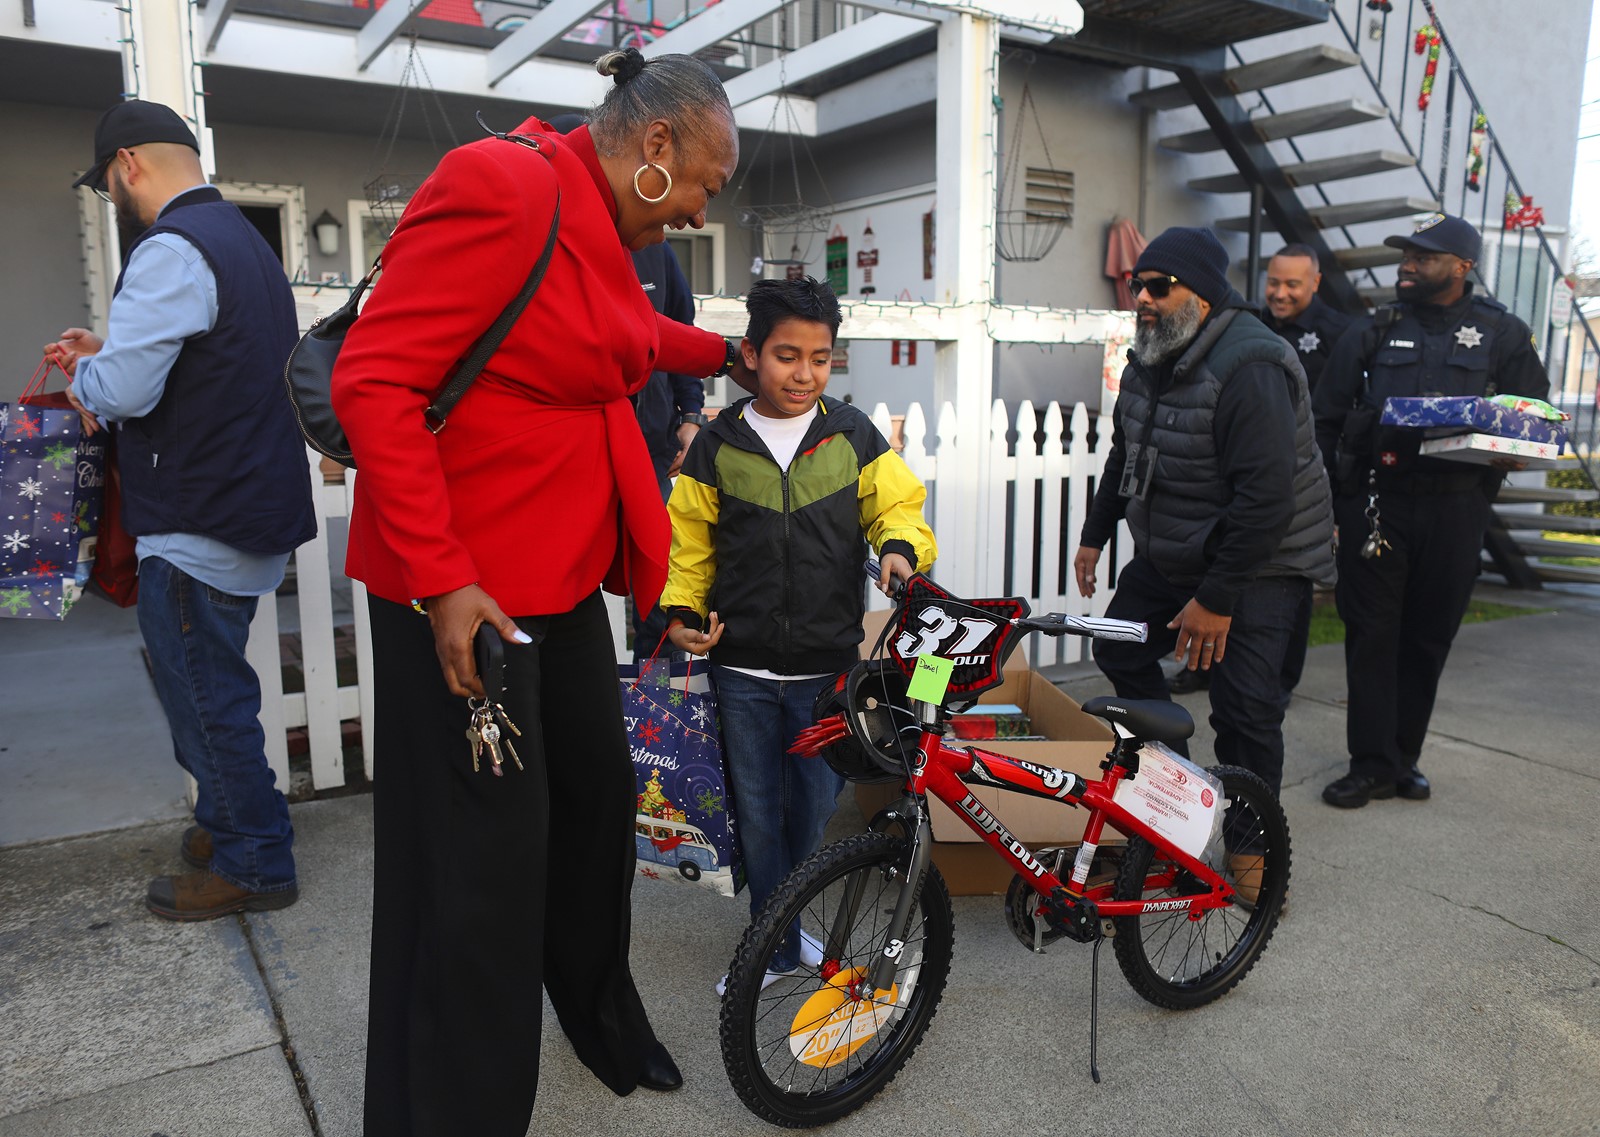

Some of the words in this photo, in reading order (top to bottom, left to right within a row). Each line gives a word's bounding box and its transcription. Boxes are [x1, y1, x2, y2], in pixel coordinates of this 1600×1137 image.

[918, 657, 939, 675] Daniel
[956, 792, 1048, 878] WIPEOUT
[1141, 899, 1194, 913] DYNACRAFT
